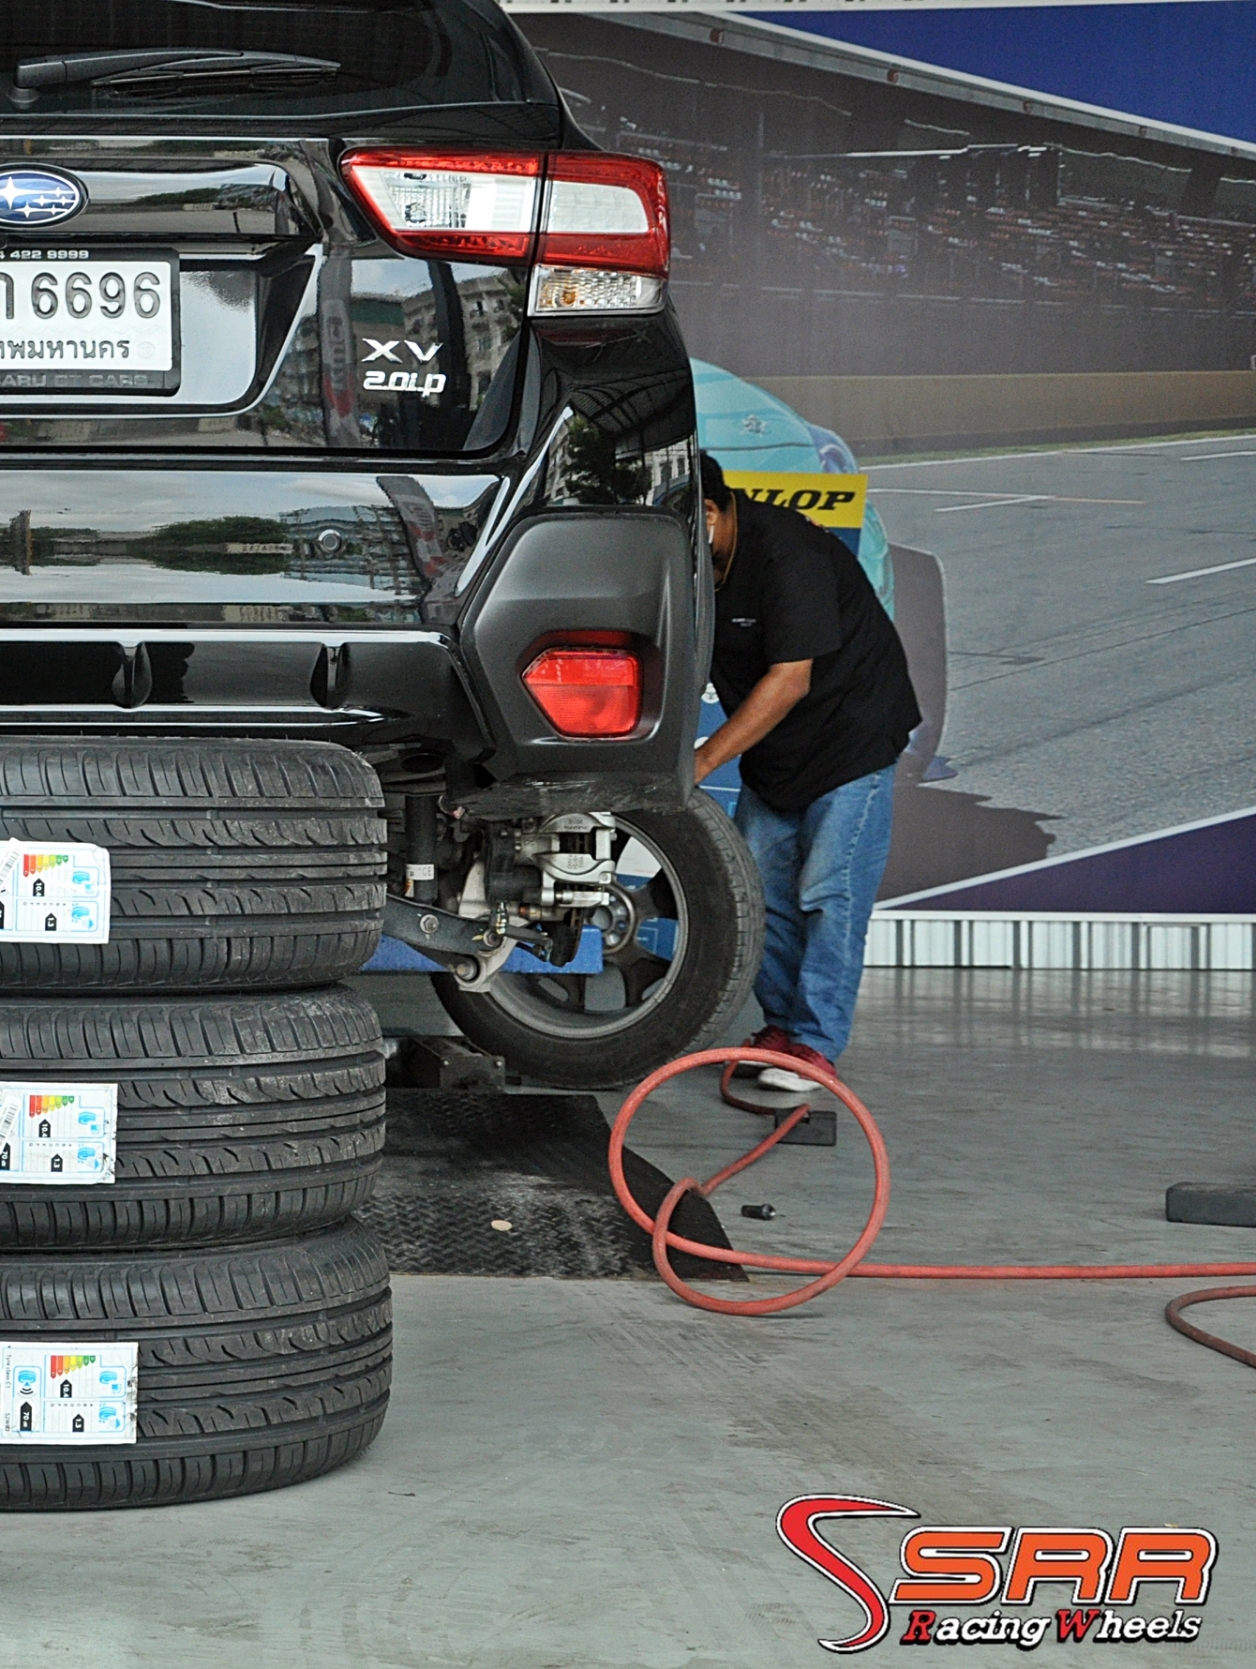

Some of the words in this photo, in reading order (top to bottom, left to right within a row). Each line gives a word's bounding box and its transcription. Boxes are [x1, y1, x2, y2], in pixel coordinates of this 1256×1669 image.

[10, 250, 42, 260] 422
[31, 271, 161, 319] 6696
[361, 338, 444, 364] XV
[88, 374, 149, 387] CARS
